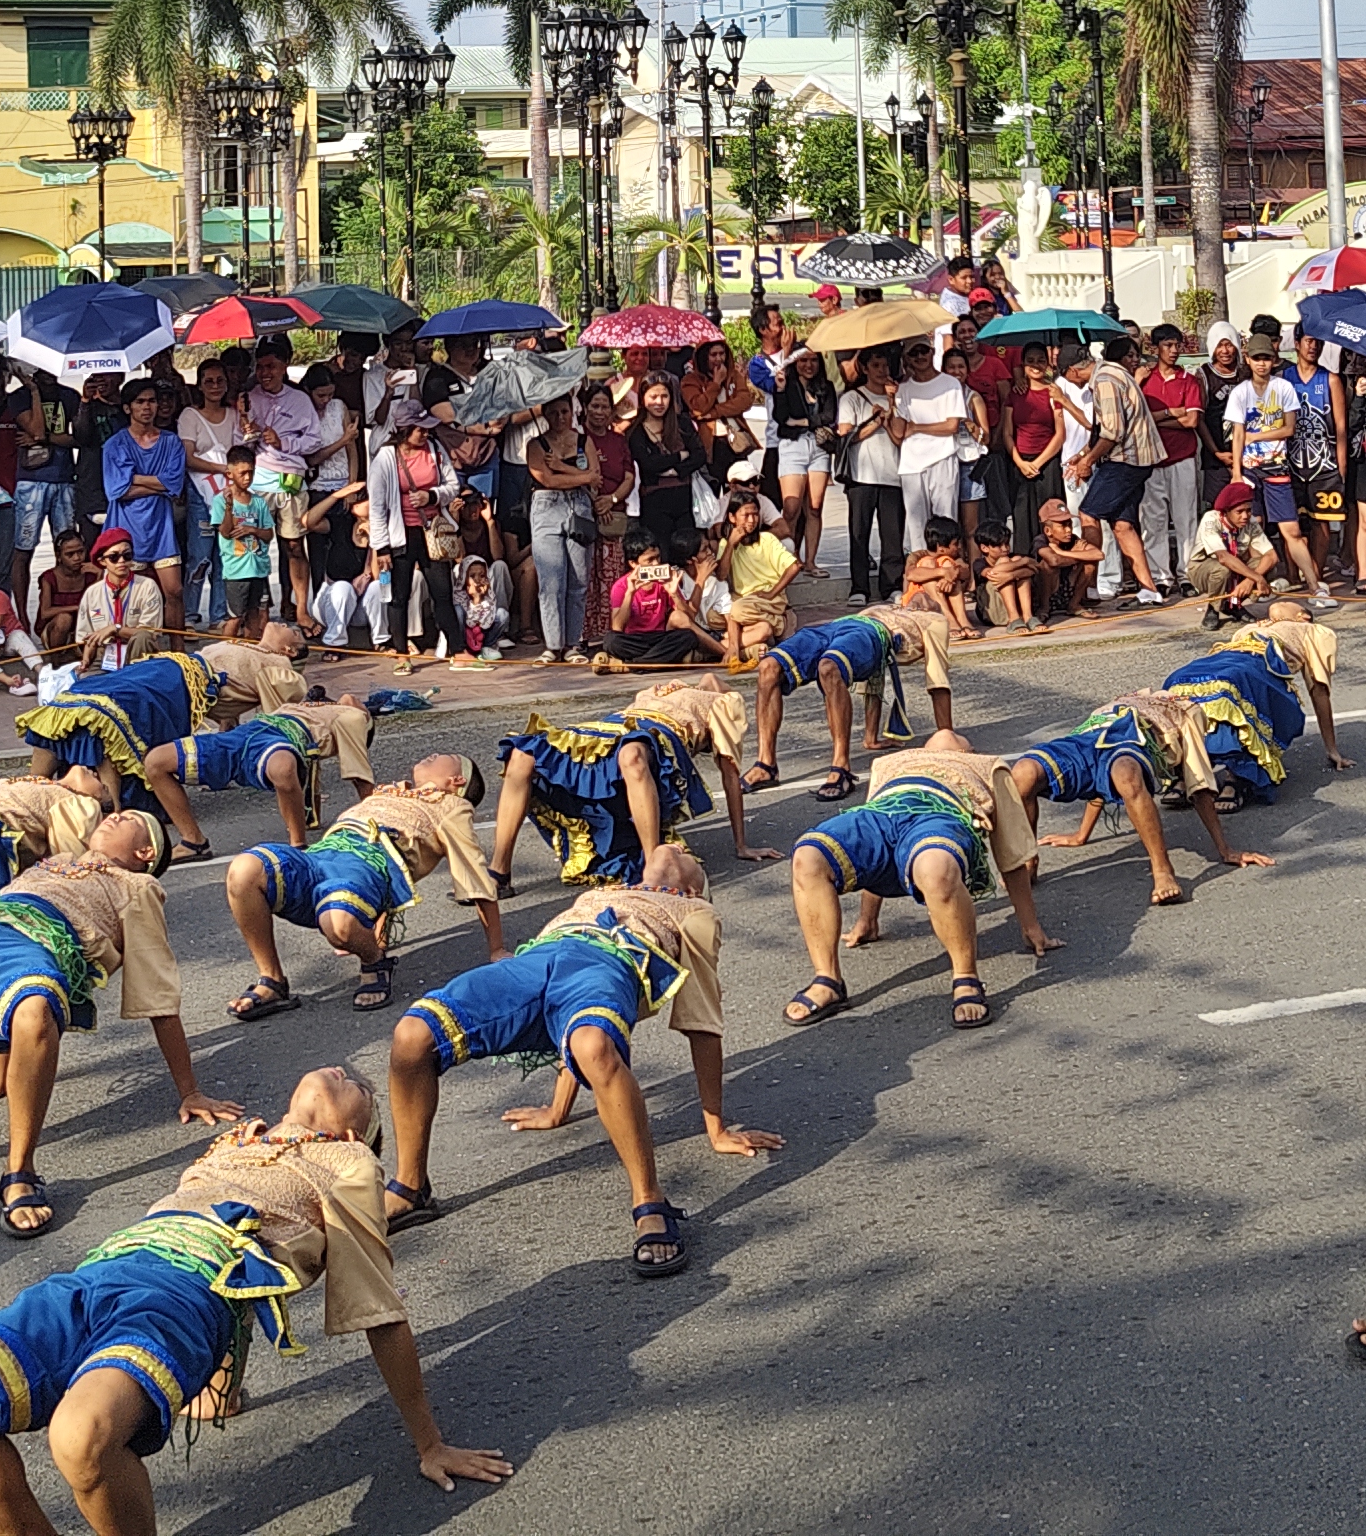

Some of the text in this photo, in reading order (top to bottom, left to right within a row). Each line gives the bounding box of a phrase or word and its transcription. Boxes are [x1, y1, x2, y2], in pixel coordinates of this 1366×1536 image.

[1333, 326, 1362, 343] VIBES
[78, 358, 122, 369] PETRON
[1316, 491, 1343, 509] 30
